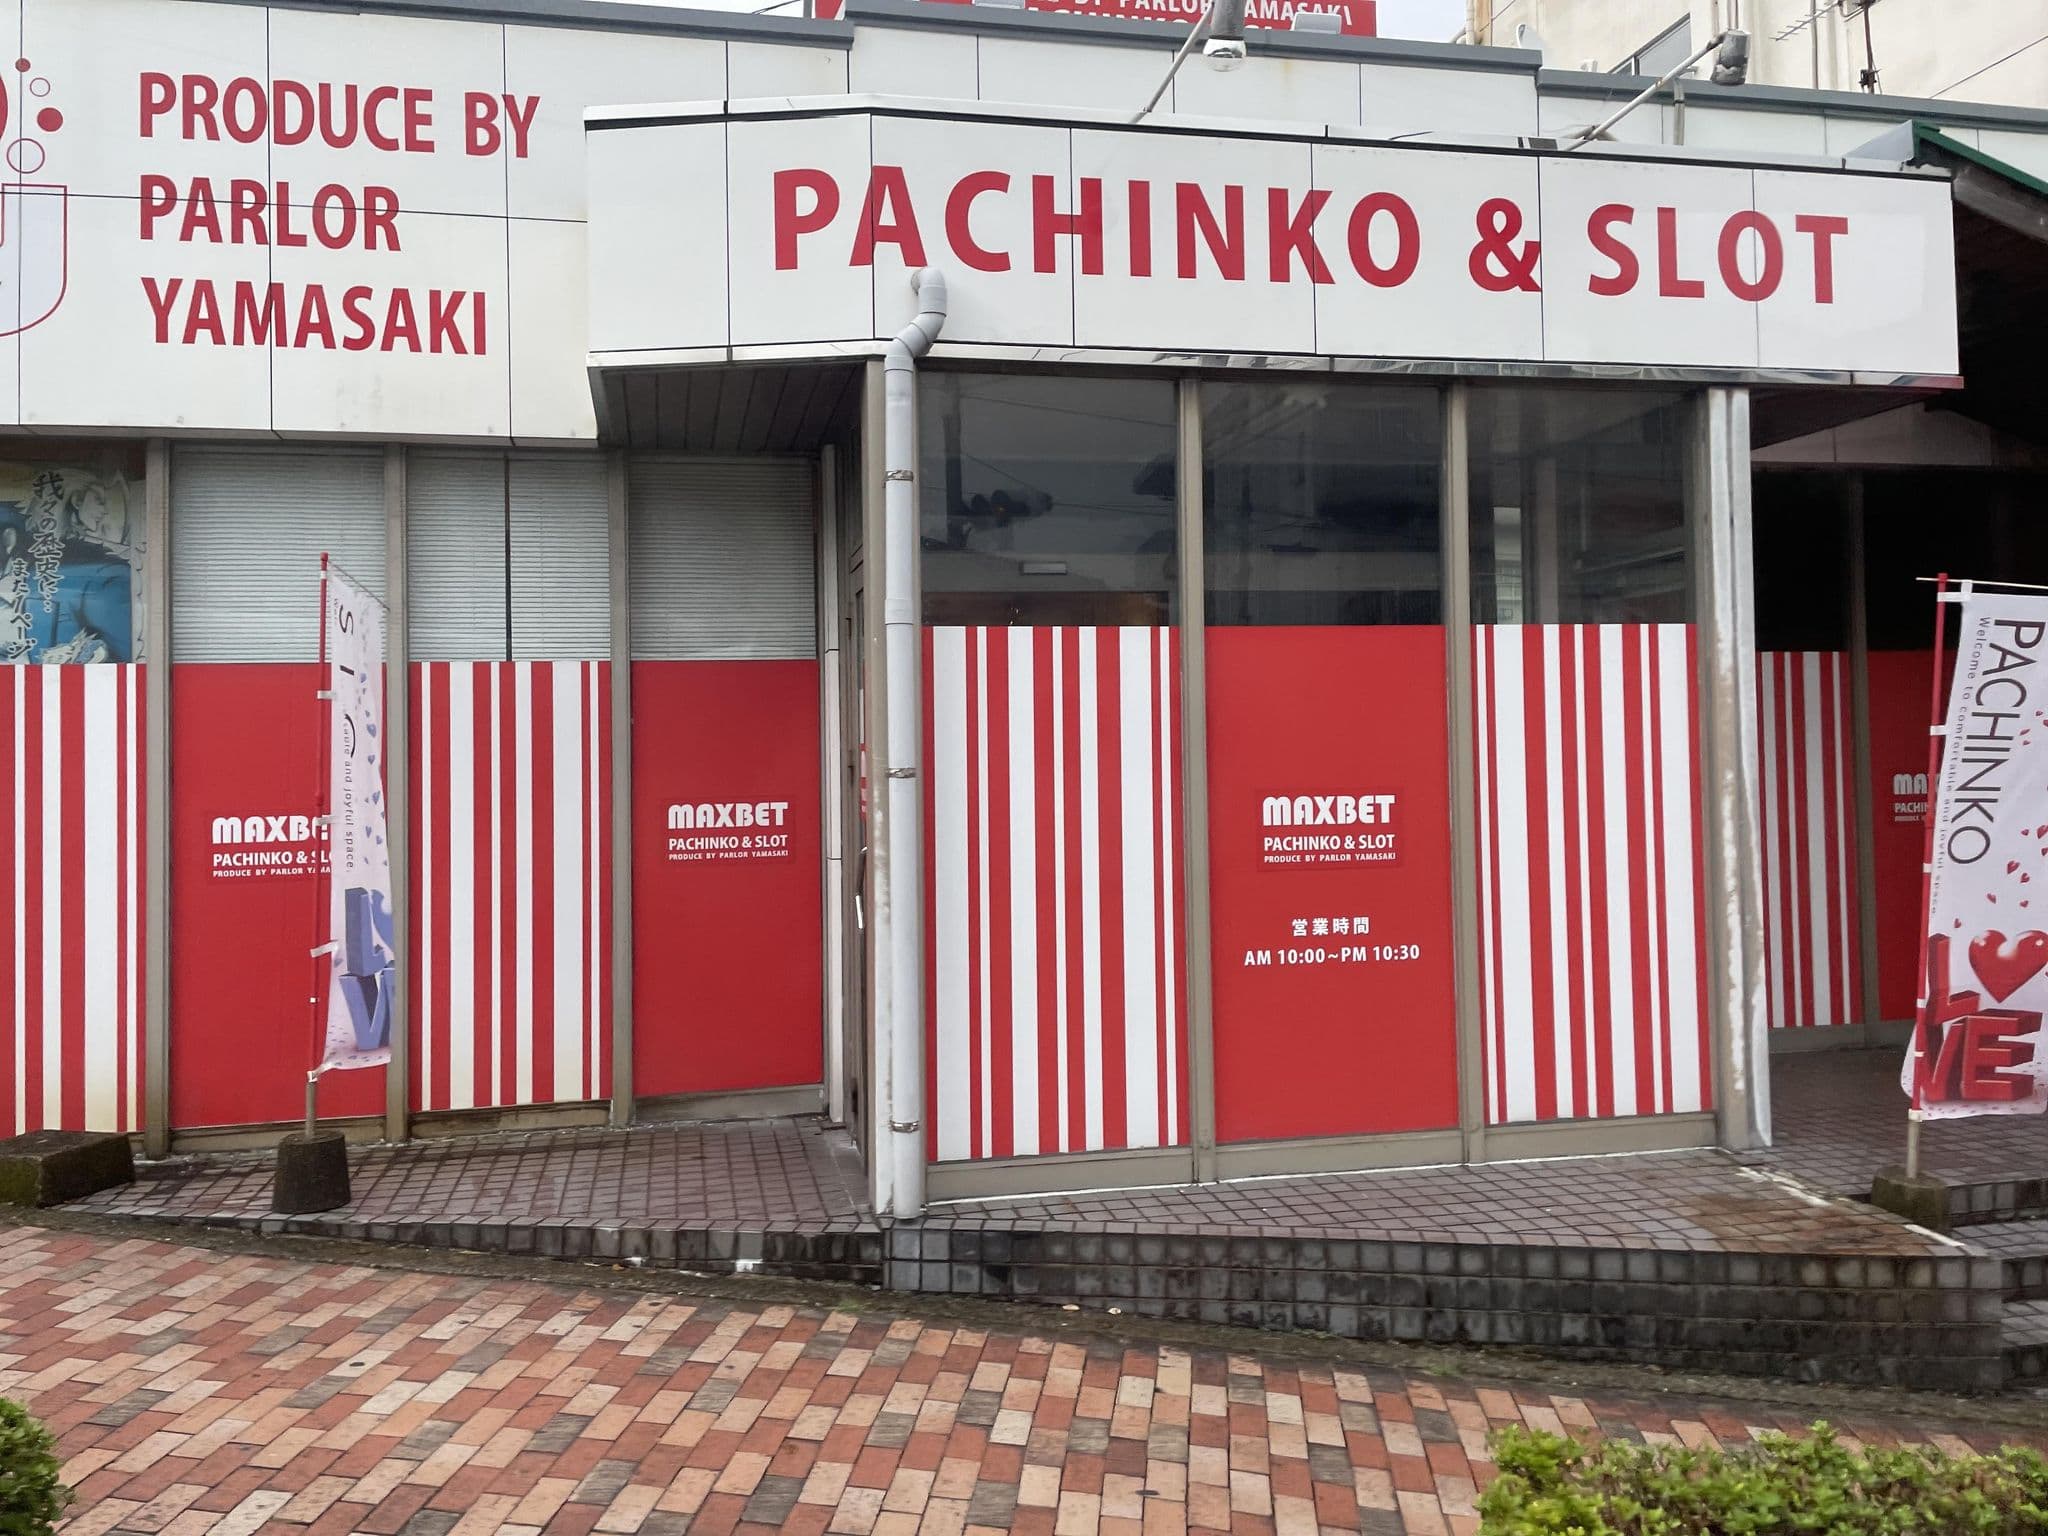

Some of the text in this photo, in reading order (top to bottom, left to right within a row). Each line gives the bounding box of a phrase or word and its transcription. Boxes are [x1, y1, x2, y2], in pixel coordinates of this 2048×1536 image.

[140, 72, 540, 158] PRODUCE BY
[140, 174, 401, 251] PARLOR
[773, 165, 1849, 304] PACHINKO & SLOT
[141, 277, 486, 355] YAMASAKI
[1967, 617, 1991, 680] Welcome
[1948, 619, 2046, 865] PACHINKO
[667, 802, 789, 829] MAXBET
[1262, 795, 1396, 826] MAXBET
[668, 834, 788, 851] PACHINKO & SLOT
[668, 849, 789, 860] PRODUCE BY PARLOR YAMASAKI
[1263, 834, 1395, 851] PACHINKO & SLOT
[212, 851, 293, 867] PACHINKO
[296, 850, 308, 864] &
[1264, 852, 1396, 863] PRODUCE BY PARLOR YAMASAKI
[212, 869, 251, 877] PRODUCE
[270, 867, 304, 875] PARLOR
[1291, 916, 1370, 937] 営業時間
[1244, 951, 1272, 966] AM
[1372, 944, 1420, 961] 10:30
